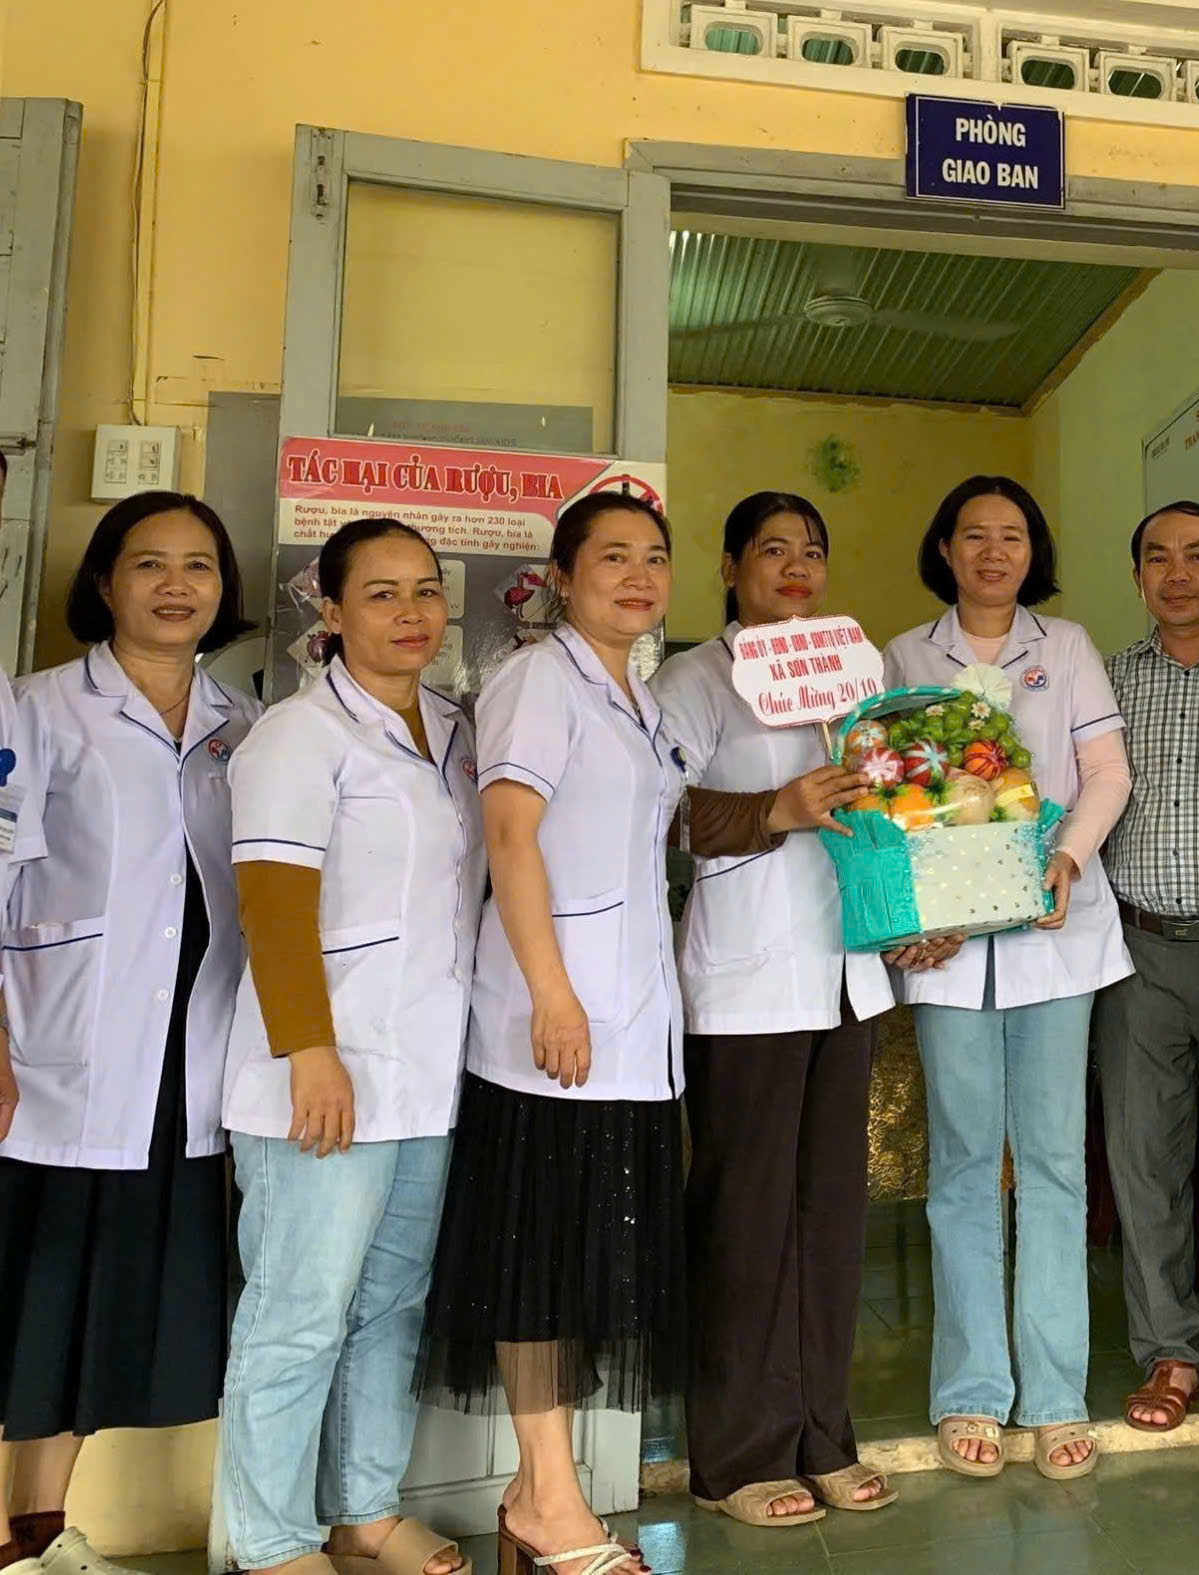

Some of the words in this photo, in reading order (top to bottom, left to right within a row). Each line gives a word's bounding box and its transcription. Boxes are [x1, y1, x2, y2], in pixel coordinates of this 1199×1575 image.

[955, 114, 1026, 147] PHÒNG
[942, 158, 991, 185] GIAO
[997, 163, 1039, 189] BAN
[288, 449, 338, 485] TÁC
[341, 460, 388, 494] HẠI
[392, 455, 442, 491] CỦA
[445, 464, 519, 502] RƯỢU,
[521, 473, 564, 500] BIA
[294, 517, 320, 527] bệnh
[323, 518, 337, 527] tật
[472, 527, 504, 539] Rượu,
[507, 529, 522, 538] bia
[524, 530, 533, 539] là
[295, 504, 328, 515] Rượu,
[331, 506, 347, 515] bia
[350, 507, 359, 516] là
[361, 509, 400, 519] nguyên
[402, 511, 428, 521] nhân
[431, 513, 449, 523] gây
[465, 514, 485, 524] hơn
[488, 516, 505, 525] 230
[507, 518, 526, 528] loại
[460, 539, 480, 548] tính
[482, 541, 500, 551] gây
[769, 659, 787, 682] XÃ
[786, 657, 810, 679] SƠN
[808, 652, 843, 675] THÀNH
[758, 692, 794, 716] Chúc
[797, 684, 836, 711] Mừng
[837, 677, 878, 704] 20/10
